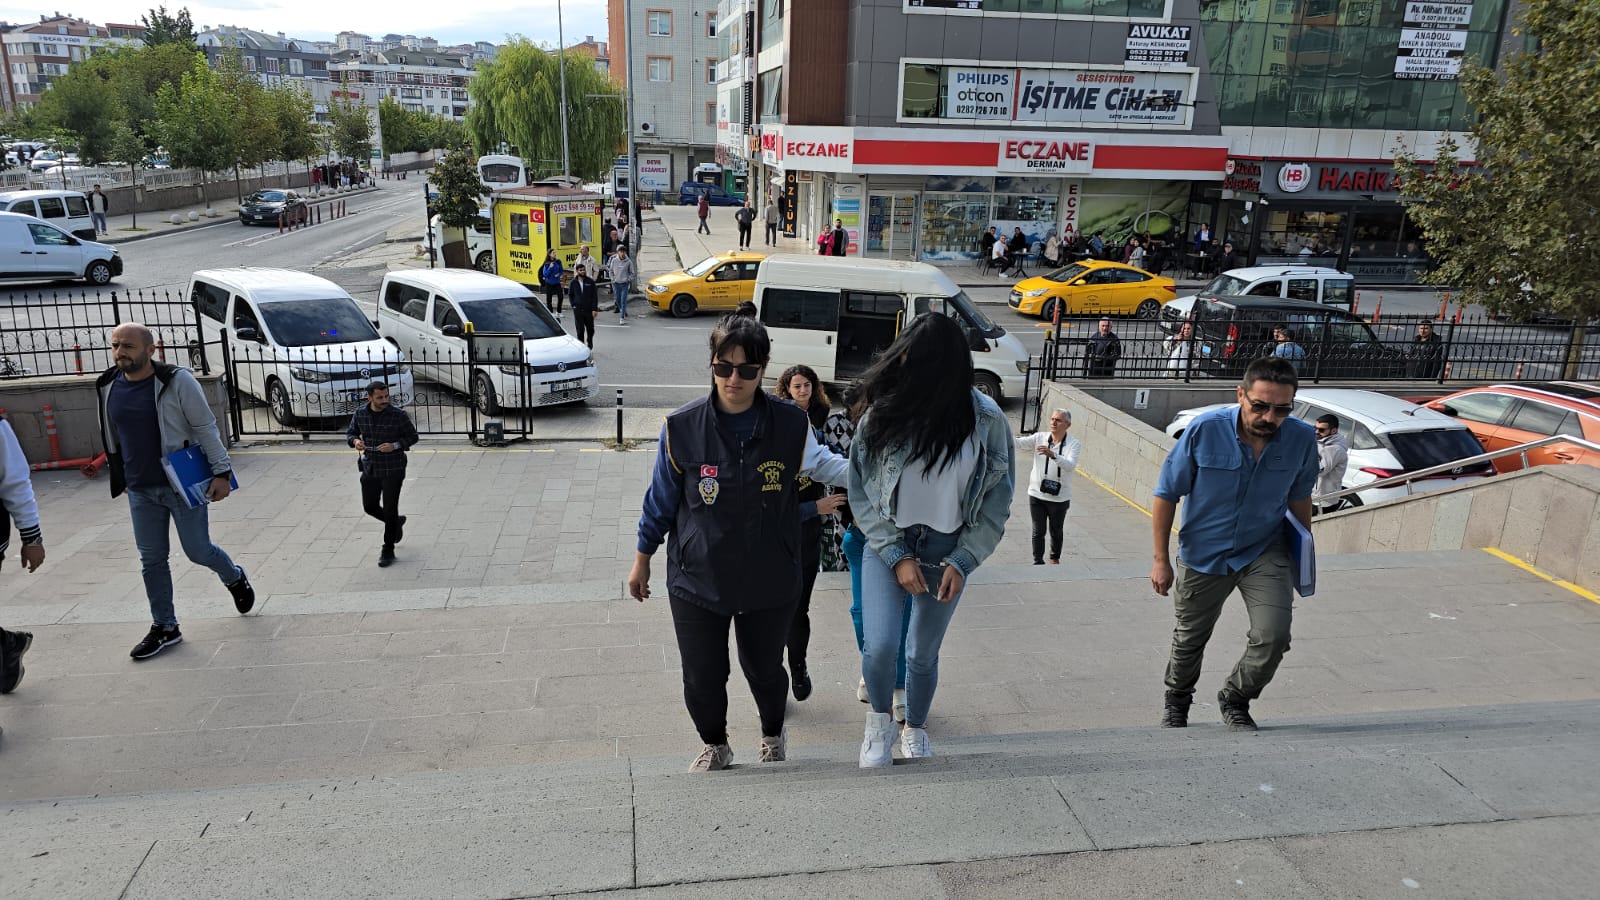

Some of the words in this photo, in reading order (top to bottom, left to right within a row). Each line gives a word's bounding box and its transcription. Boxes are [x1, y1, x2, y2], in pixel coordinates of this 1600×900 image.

[1130, 25, 1190, 39] AVUKAT
[1414, 32, 1452, 40] ANADOLU
[1410, 49, 1449, 57] AVUKAT
[957, 73, 1009, 85] PHILIPS
[957, 88, 1005, 103] oticon
[1020, 80, 1101, 113] İŞİTME
[956, 105, 975, 115] 0282
[787, 142, 849, 158] ECZANE
[1006, 141, 1089, 160] ECZANE
[1027, 160, 1066, 169] DERMAN
[1063, 184, 1078, 246] ECZAN
[510, 250, 532, 260] HUZUR
